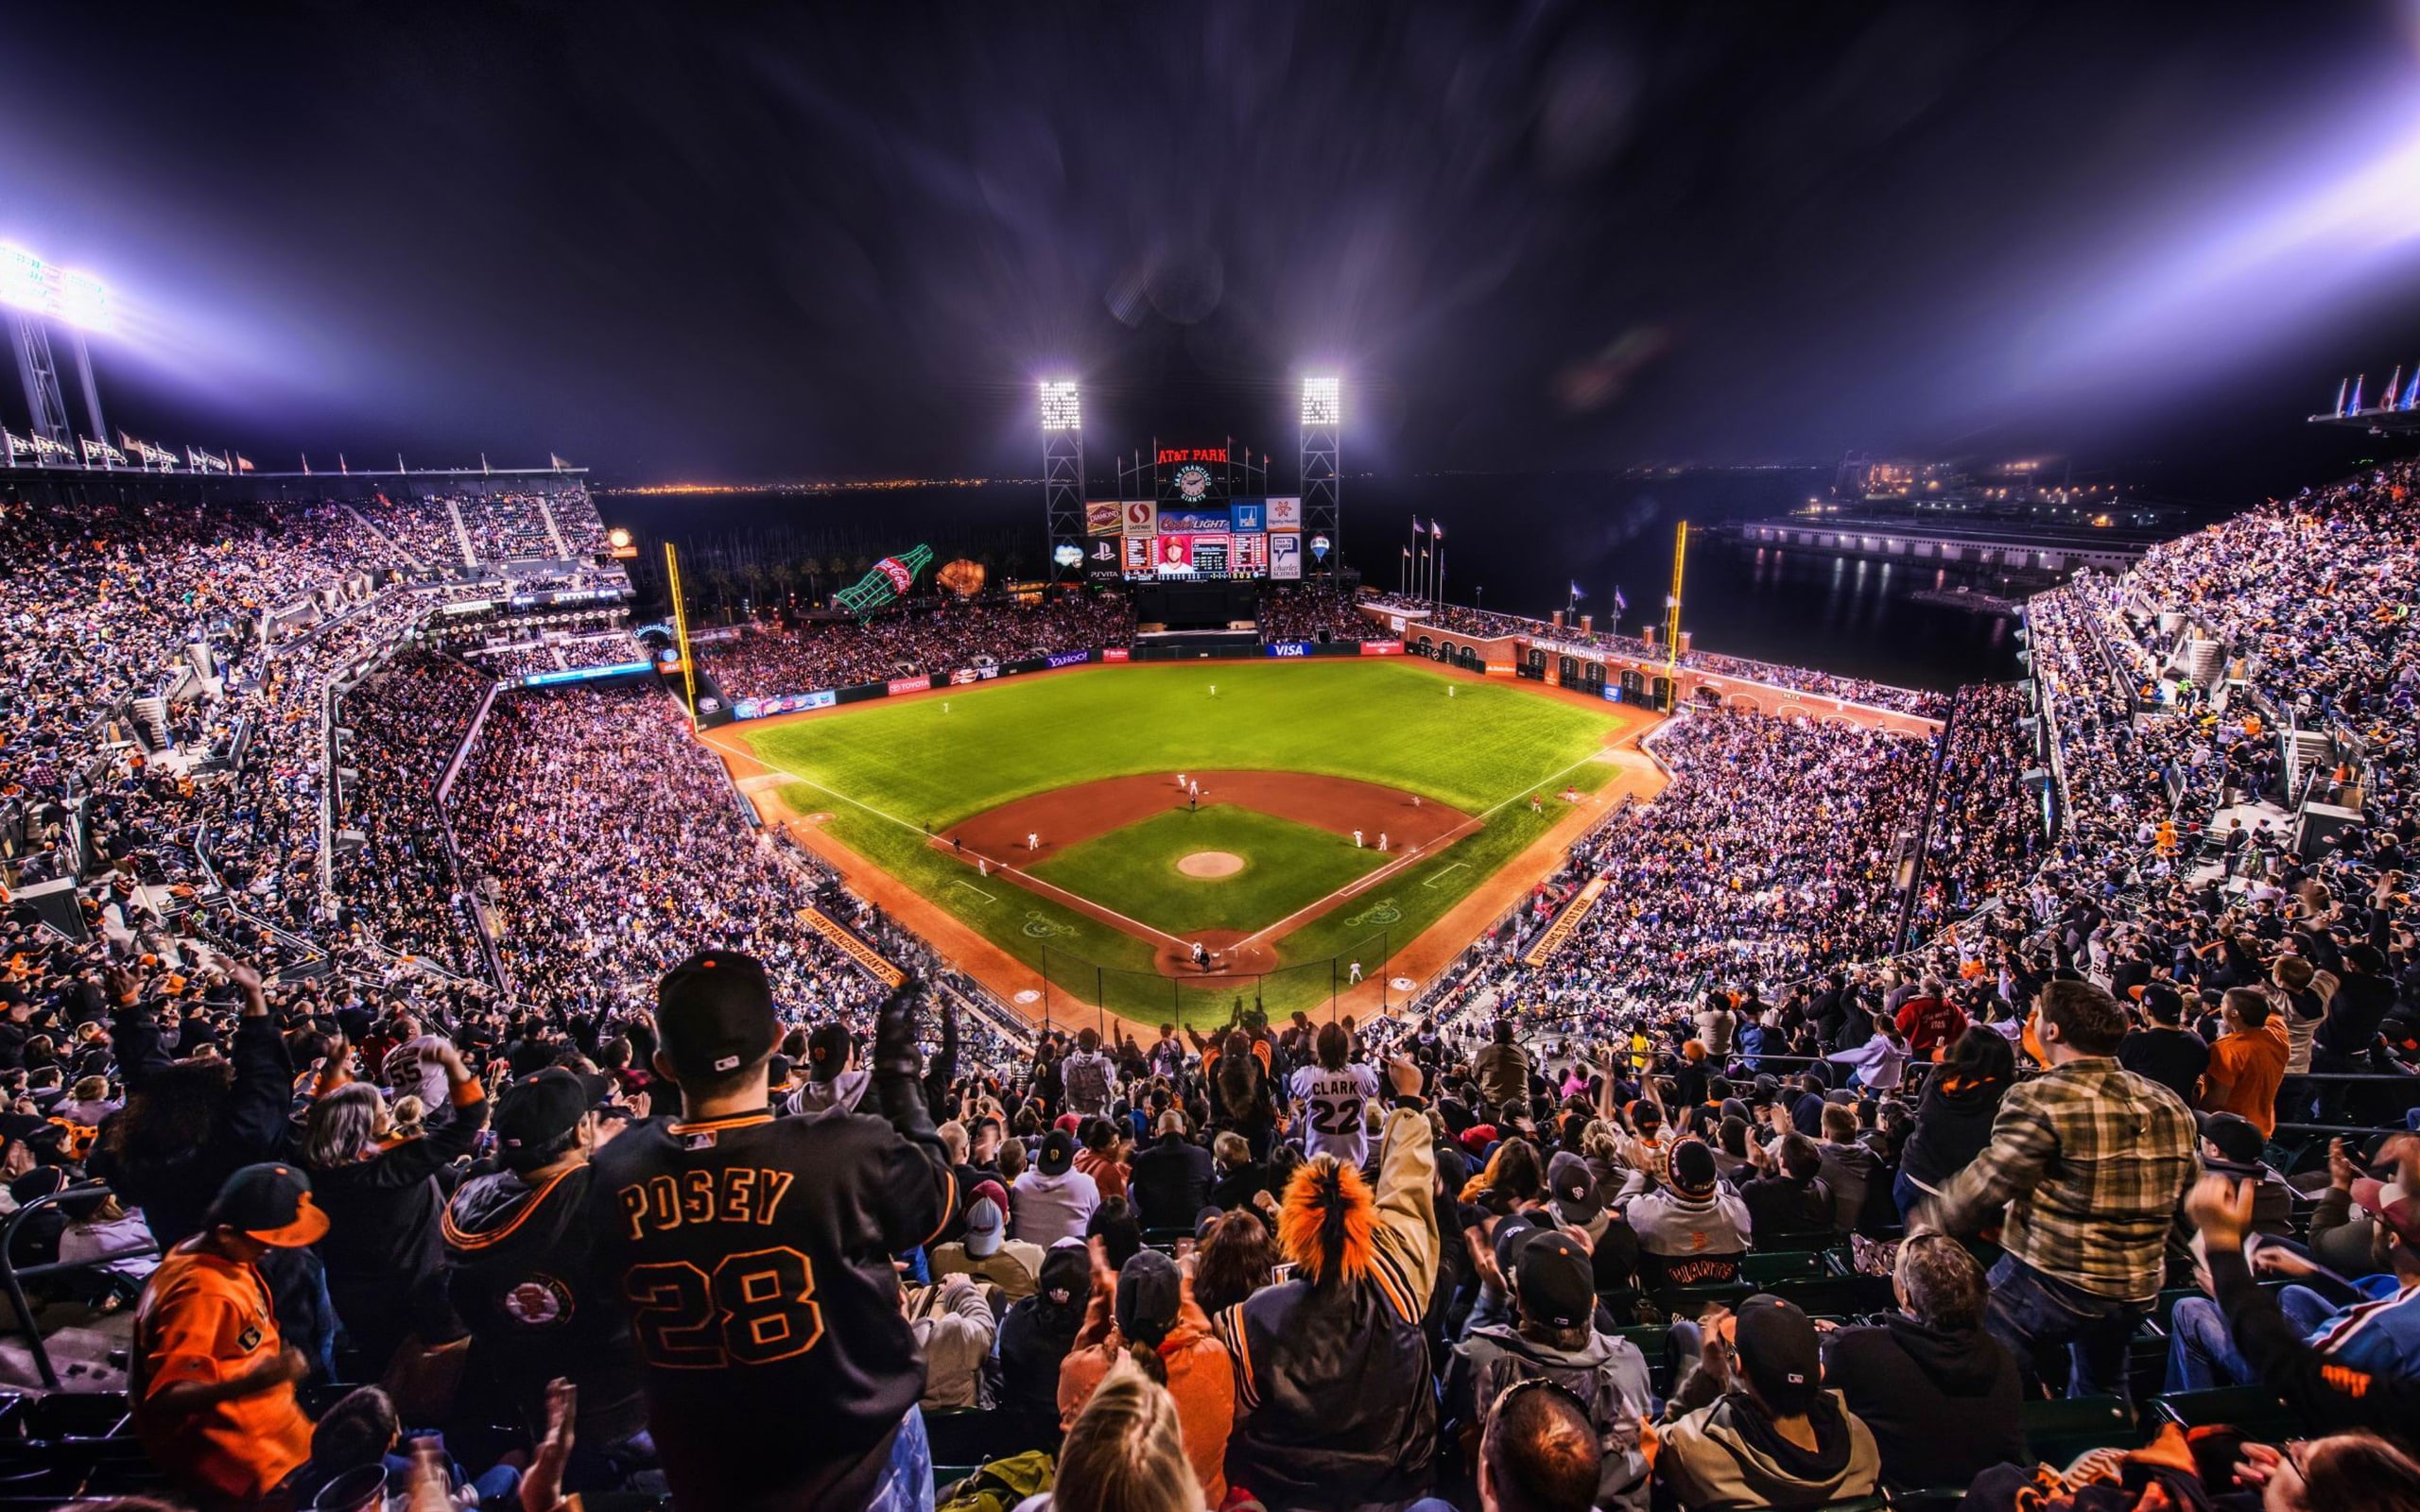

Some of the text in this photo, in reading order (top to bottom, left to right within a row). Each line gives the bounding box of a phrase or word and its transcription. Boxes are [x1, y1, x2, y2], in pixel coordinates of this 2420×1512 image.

[1158, 449, 1227, 464] AT&T PARK
[1174, 465, 1211, 487] SAN FRANCISCO
[1181, 493, 1206, 502] GIANTS
[1090, 510, 1119, 523] DIAMOND
[1193, 519, 1226, 528] LIGHT
[632, 624, 672, 638] Ghirardelli
[1274, 644, 1304, 656] VISA
[1559, 645, 1605, 662] LANDING
[900, 679, 929, 690] TOYOTA
[1531, 898, 1591, 960] WELCOME TO AT&T PARK
[813, 916, 827, 930] SAN
[823, 926, 864, 954] FRANCISCO
[858, 950, 890, 975] GIANTS
[2093, 962, 2112, 980] 28
[389, 1059, 423, 1087] 55
[1312, 1081, 1358, 1095] CLARK
[1311, 1099, 1361, 1135] 22
[617, 1167, 795, 1241] POSEY
[1669, 1260, 1734, 1283] GIANTS
[623, 1246, 825, 1369] 28
